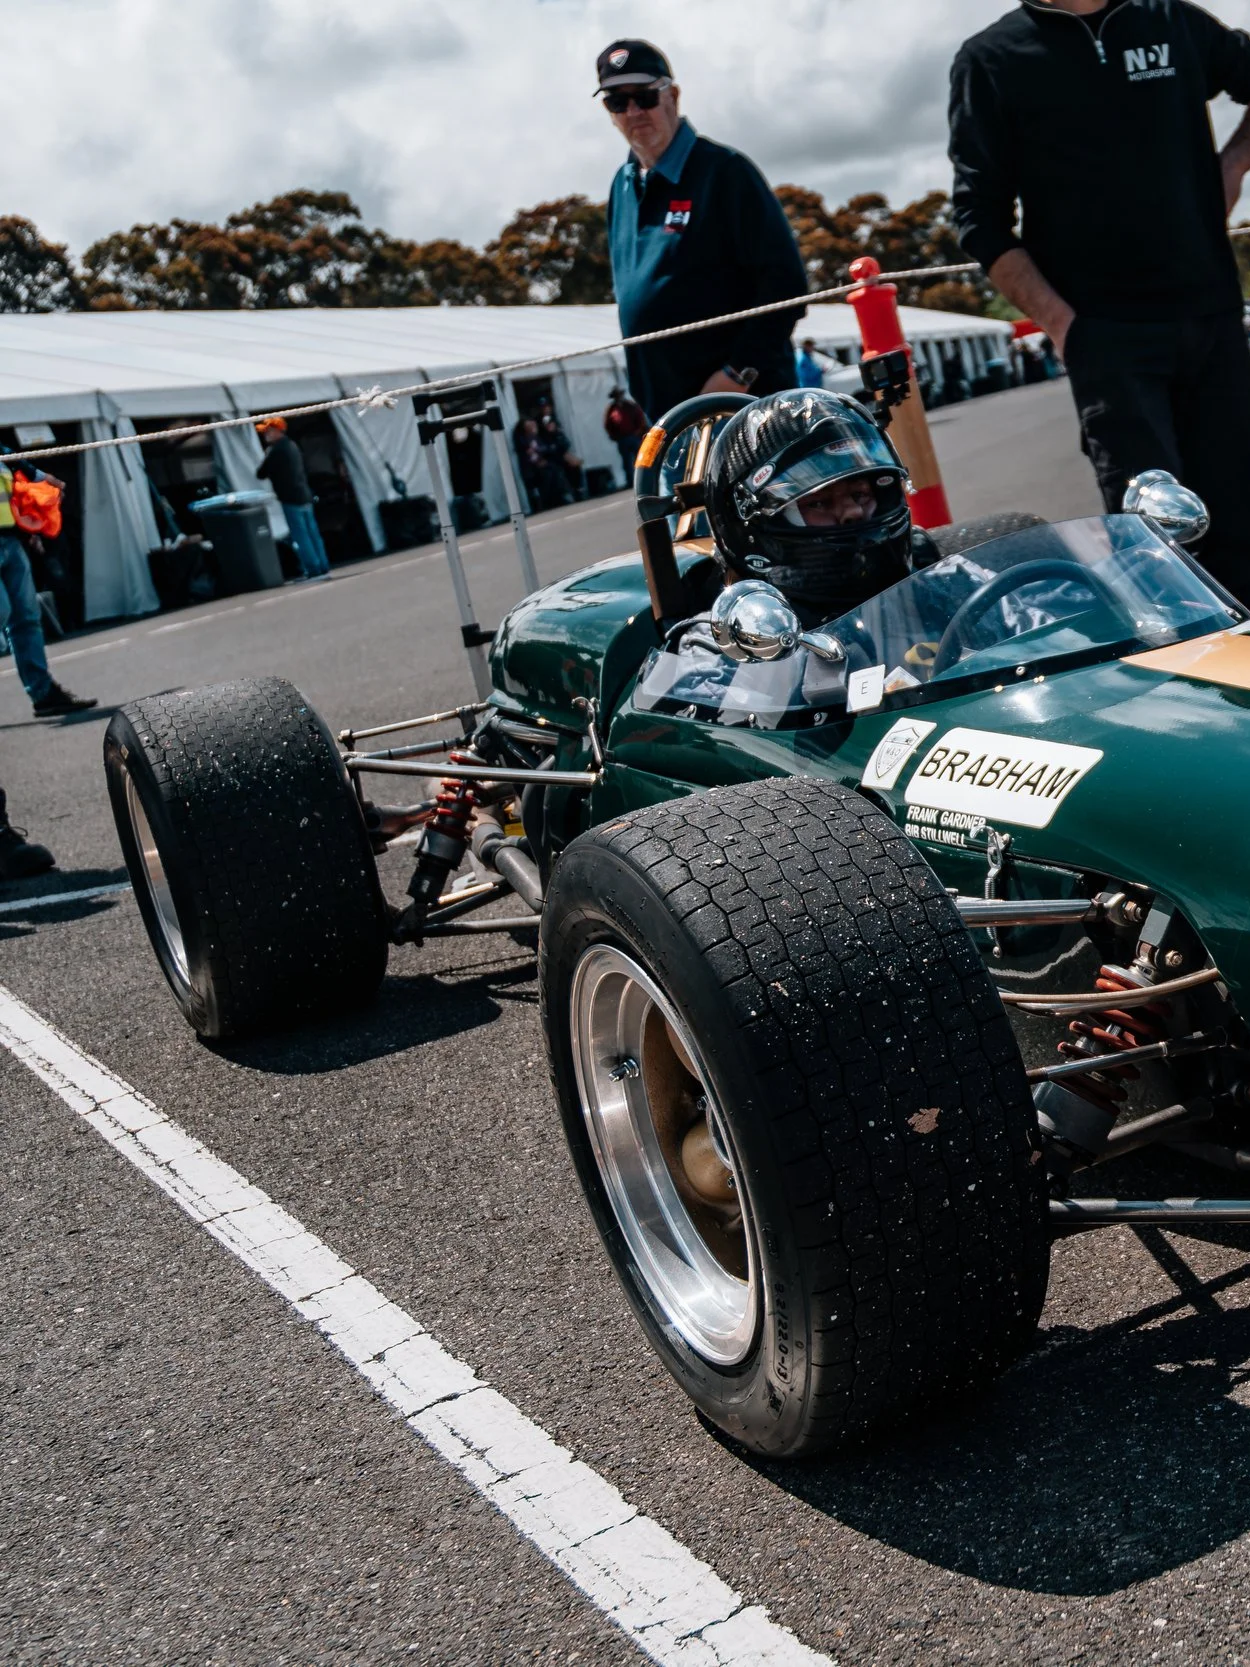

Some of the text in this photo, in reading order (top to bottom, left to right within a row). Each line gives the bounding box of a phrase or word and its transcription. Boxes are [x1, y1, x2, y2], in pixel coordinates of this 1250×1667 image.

[1128, 67, 1176, 81] MOTORSPORT
[754, 467, 771, 484] BELL
[861, 681, 869, 695] E
[919, 747, 1081, 800] BRABHAM
[906, 805, 986, 831] FRANK GARDNER
[904, 823, 968, 848] BIB STILLWELL
